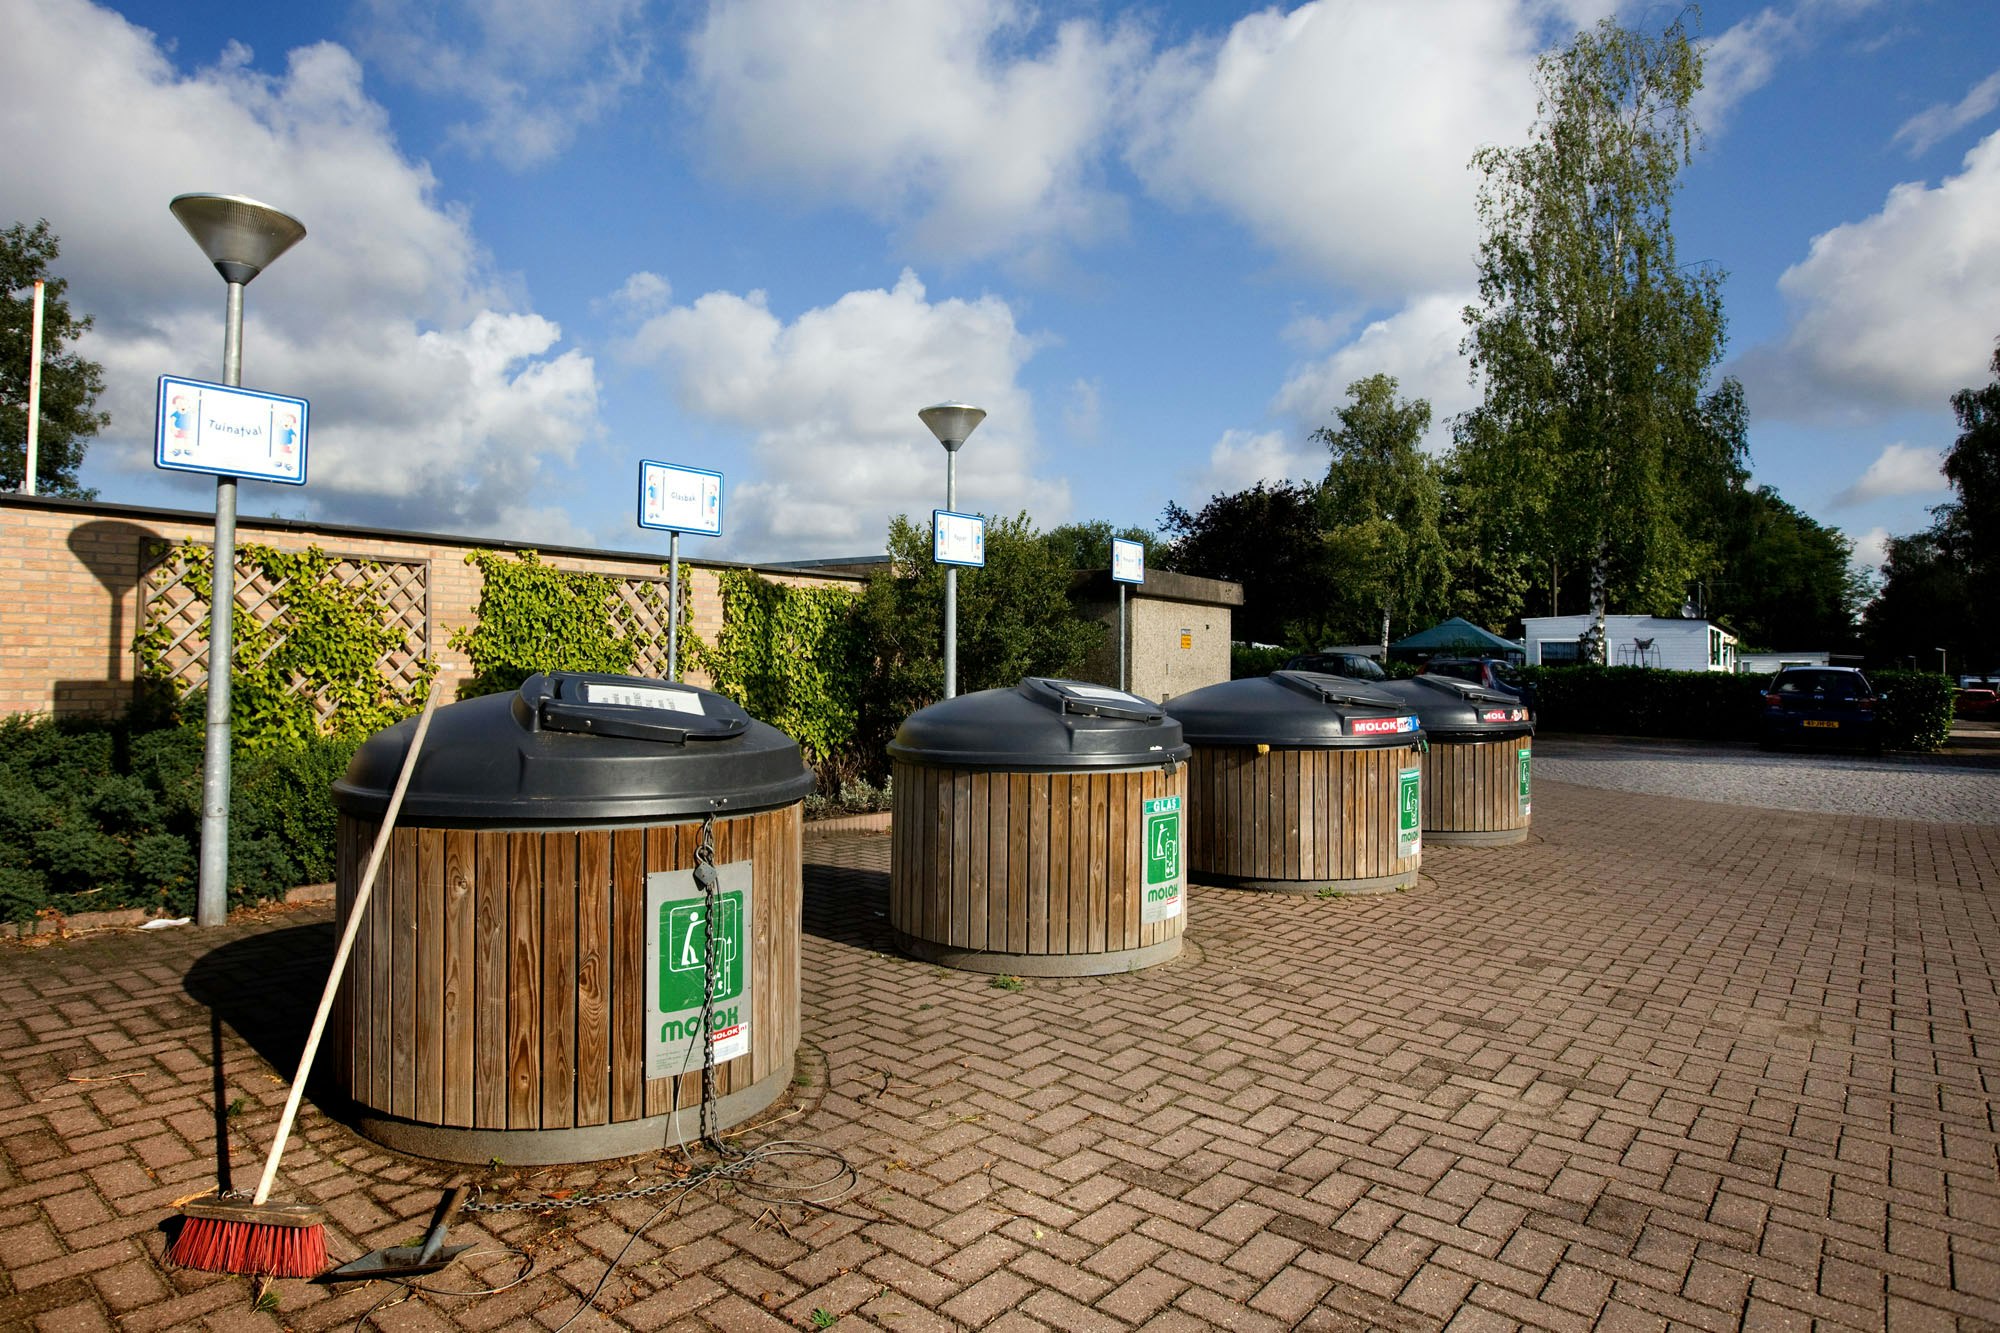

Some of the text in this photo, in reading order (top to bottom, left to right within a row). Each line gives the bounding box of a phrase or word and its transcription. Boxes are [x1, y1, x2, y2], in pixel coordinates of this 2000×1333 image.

[1354, 721, 1397, 732] MOLOK
[1153, 799, 1177, 812] GLAS
[661, 1006, 739, 1043] MOOK
